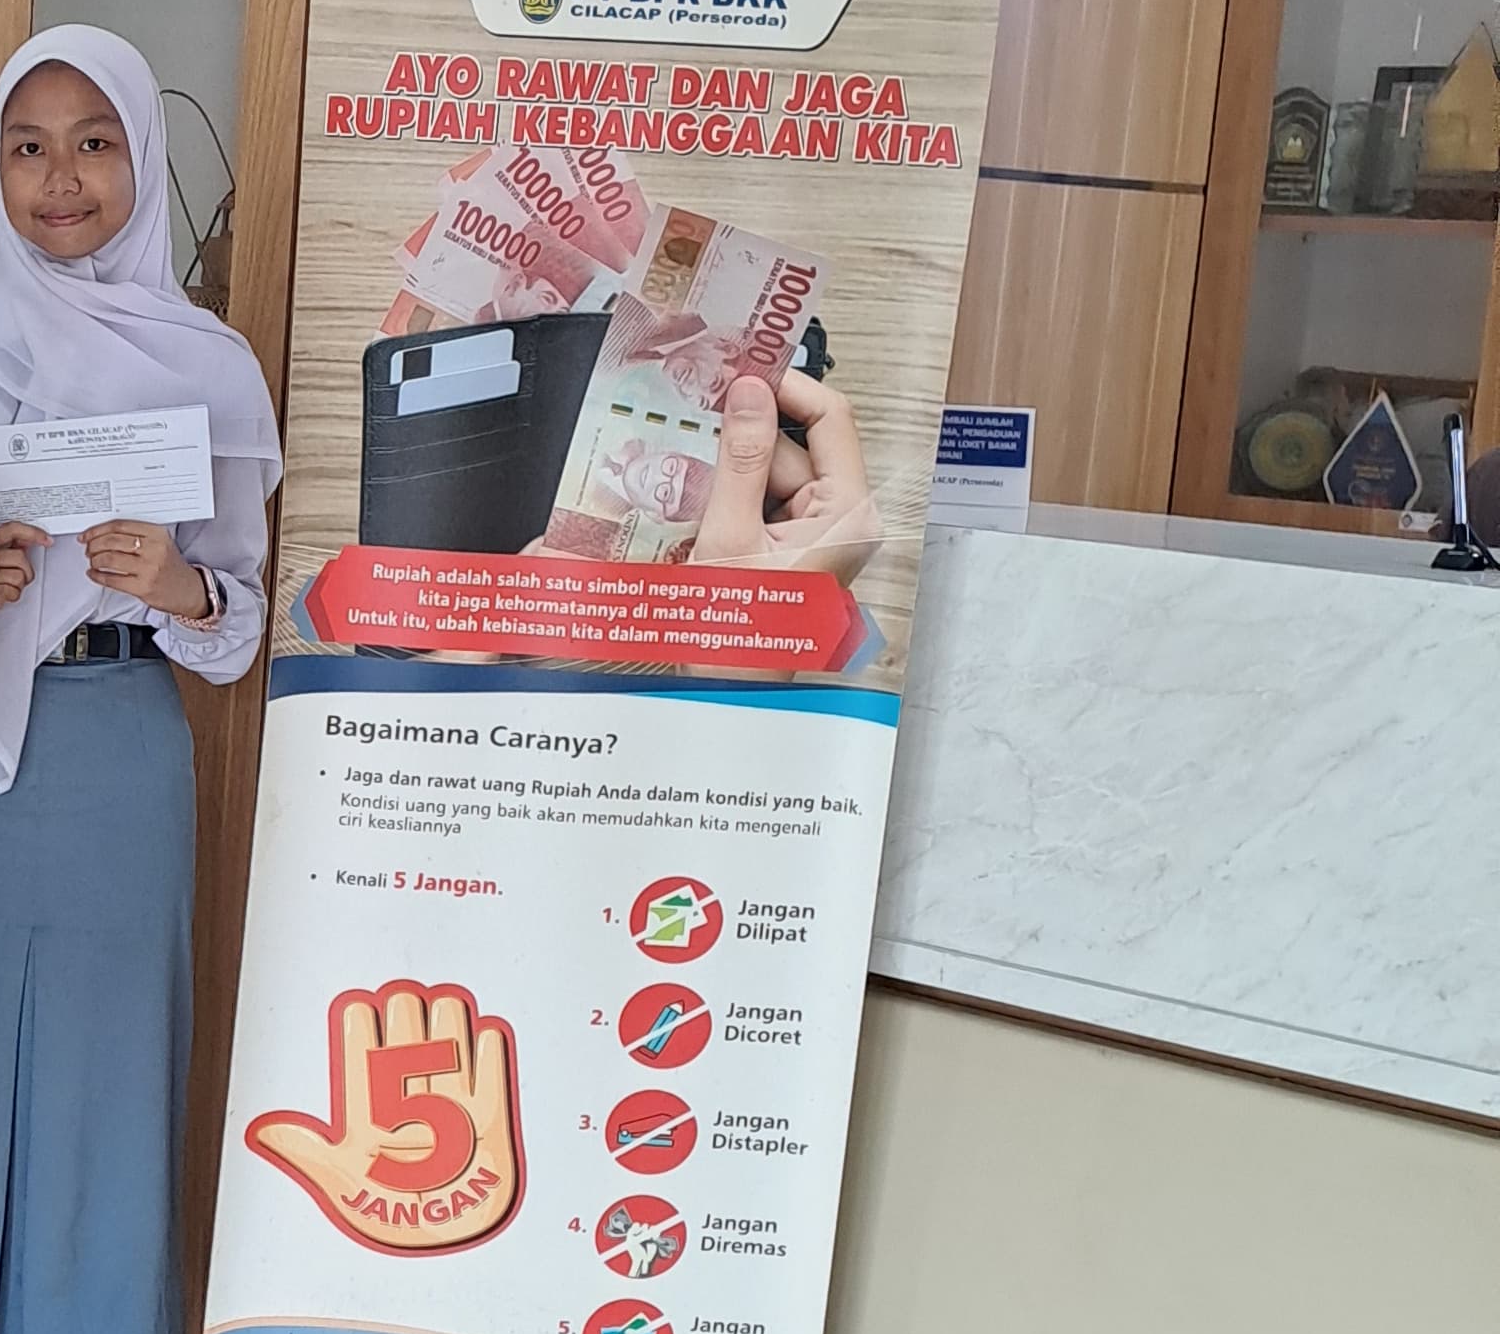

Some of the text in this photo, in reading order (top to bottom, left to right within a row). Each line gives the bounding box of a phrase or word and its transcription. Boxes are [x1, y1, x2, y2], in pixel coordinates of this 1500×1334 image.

[570, 4, 788, 29] CILACAP (Perseroda)
[384, 52, 907, 117] AYO RAWAT DAN JAGA
[326, 95, 497, 142] RUPIAH
[511, 104, 841, 160] KEBANGGAAN
[854, 122, 961, 166] KITA
[504, 147, 586, 240] 100000
[451, 200, 543, 268] 100000
[747, 262, 817, 366] 100000
[372, 564, 805, 604] Rupiah adalah salah satu simbol negara yang harus
[418, 589, 753, 625] kita jaga kehormatannya di mata dunia.
[347, 609, 819, 654] Untuk itu, ubah kebiasaan kita dalam menggunakannya.
[325, 715, 618, 758] Bagaimana Caranya?
[344, 767, 863, 816] Jaga dan rawat uang Rupiah Anda dalam kondisi yang baik.
[338, 814, 462, 836] ciri keasliannya
[340, 792, 822, 837] Kondisi uang yang baik akan memudahkan kita mengenali
[336, 870, 503, 897] Kenali 5 Jangan.
[603, 900, 815, 924] 1. Jangan
[736, 922, 807, 944] Dilipat
[590, 1002, 803, 1026] 2. Jangan
[724, 1025, 802, 1045] Dicoret
[365, 1038, 477, 1193] 5
[579, 1111, 789, 1132] 3. Jangan
[712, 1133, 809, 1155] Distapler
[340, 1166, 501, 1227] JANGAN
[568, 1214, 778, 1235] 4. Jangan
[701, 1236, 787, 1257] Diremas
